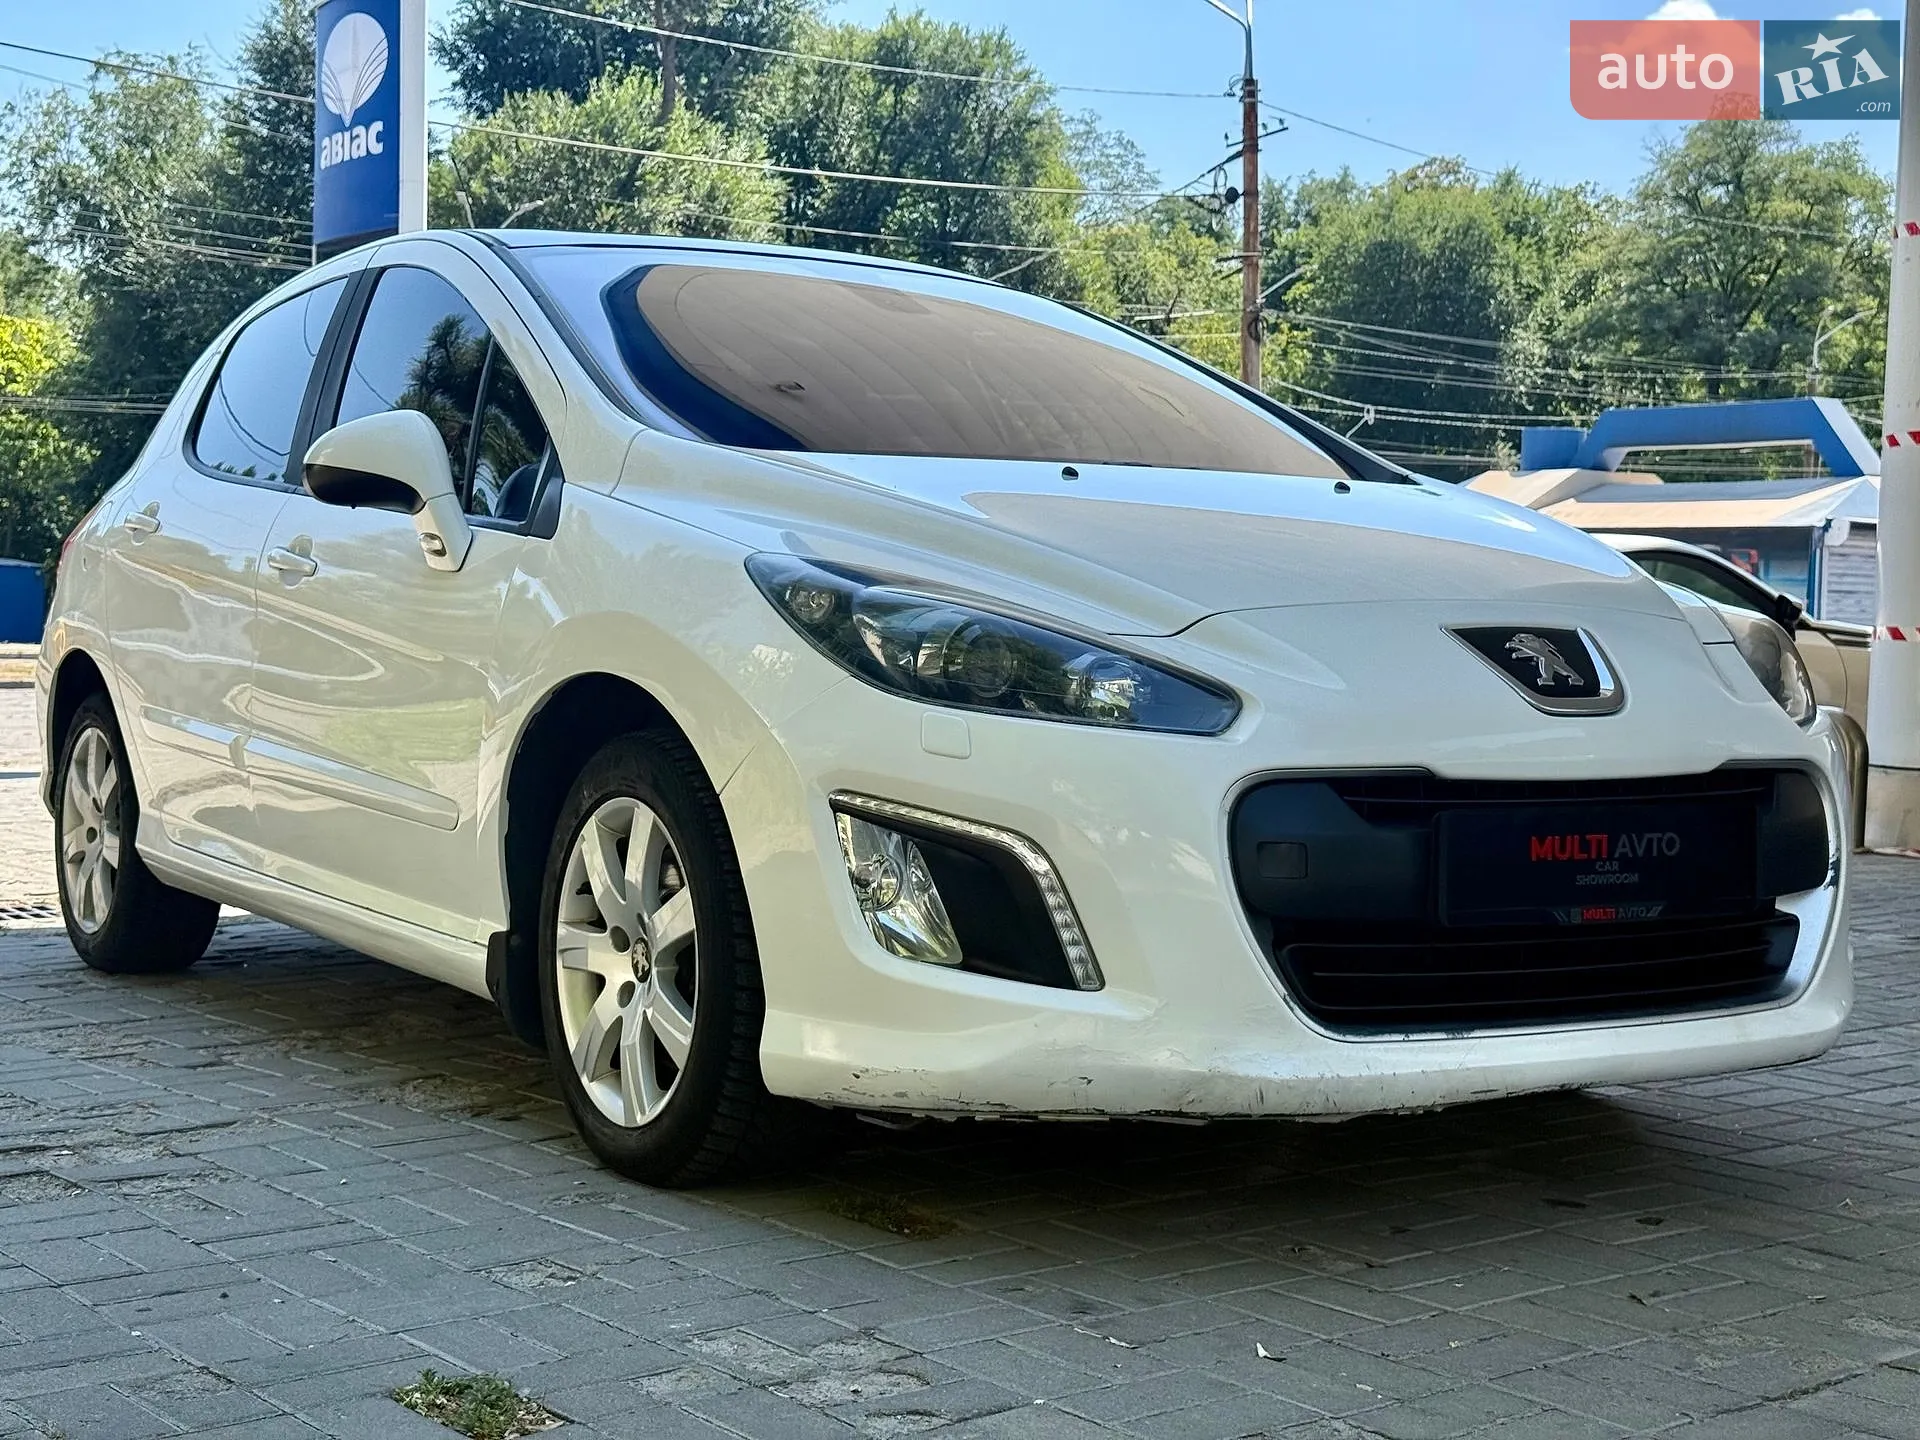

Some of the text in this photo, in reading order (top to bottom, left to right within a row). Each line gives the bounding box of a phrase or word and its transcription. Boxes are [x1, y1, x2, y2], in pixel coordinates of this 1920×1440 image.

[1531, 831, 1681, 862] MULTI AVTO
[1595, 860, 1620, 872] CAR
[1575, 872, 1639, 886] SHOWROOM
[1583, 906, 1647, 920] MULTI AVTO
